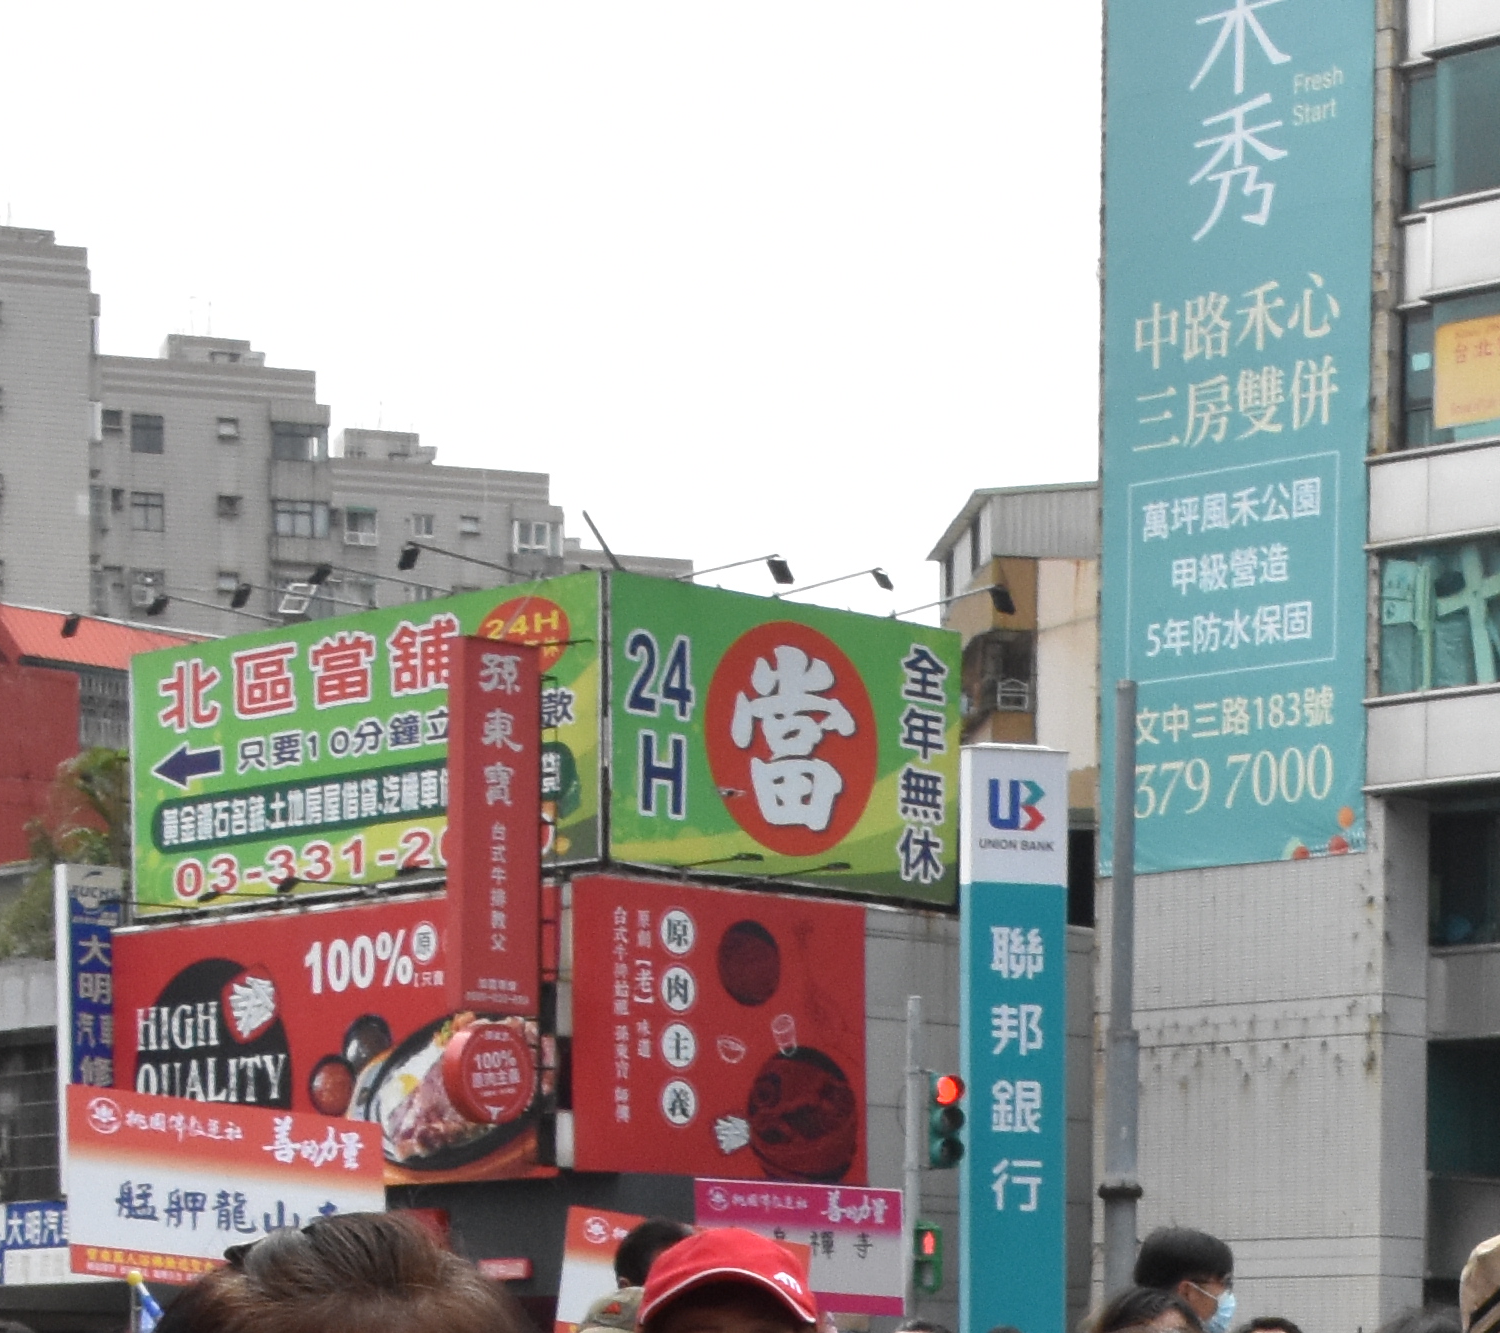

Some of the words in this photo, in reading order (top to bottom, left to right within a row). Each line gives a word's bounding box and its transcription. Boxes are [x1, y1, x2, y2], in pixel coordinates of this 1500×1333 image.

[1294, 65, 1343, 96] Fresh
[1292, 98, 1336, 128] Start
[1134, 273, 1339, 373] 中路禾心
[1132, 360, 1339, 454] 三房雙併
[1143, 477, 1321, 541] 萬坪風禾公園
[1171, 545, 1290, 598] 甲級營造
[1146, 601, 1312, 659] 5年防水保固
[158, 612, 461, 733] 北區當舖
[731, 644, 856, 832] 當
[1134, 686, 1335, 747] 文中三路183號
[899, 643, 947, 885] 全年無休
[1134, 754, 1211, 820] 379
[1225, 743, 1333, 809] 7000
[979, 837, 1017, 852] UNION
[1021, 838, 1054, 854] BANK
[304, 928, 414, 993] 100%
[136, 1000, 219, 1053] HIGH
[664, 917, 691, 1119] 原肉主義
[137, 1053, 286, 1103] QUALITY
[990, 925, 1043, 1213] 聯邦銀行
